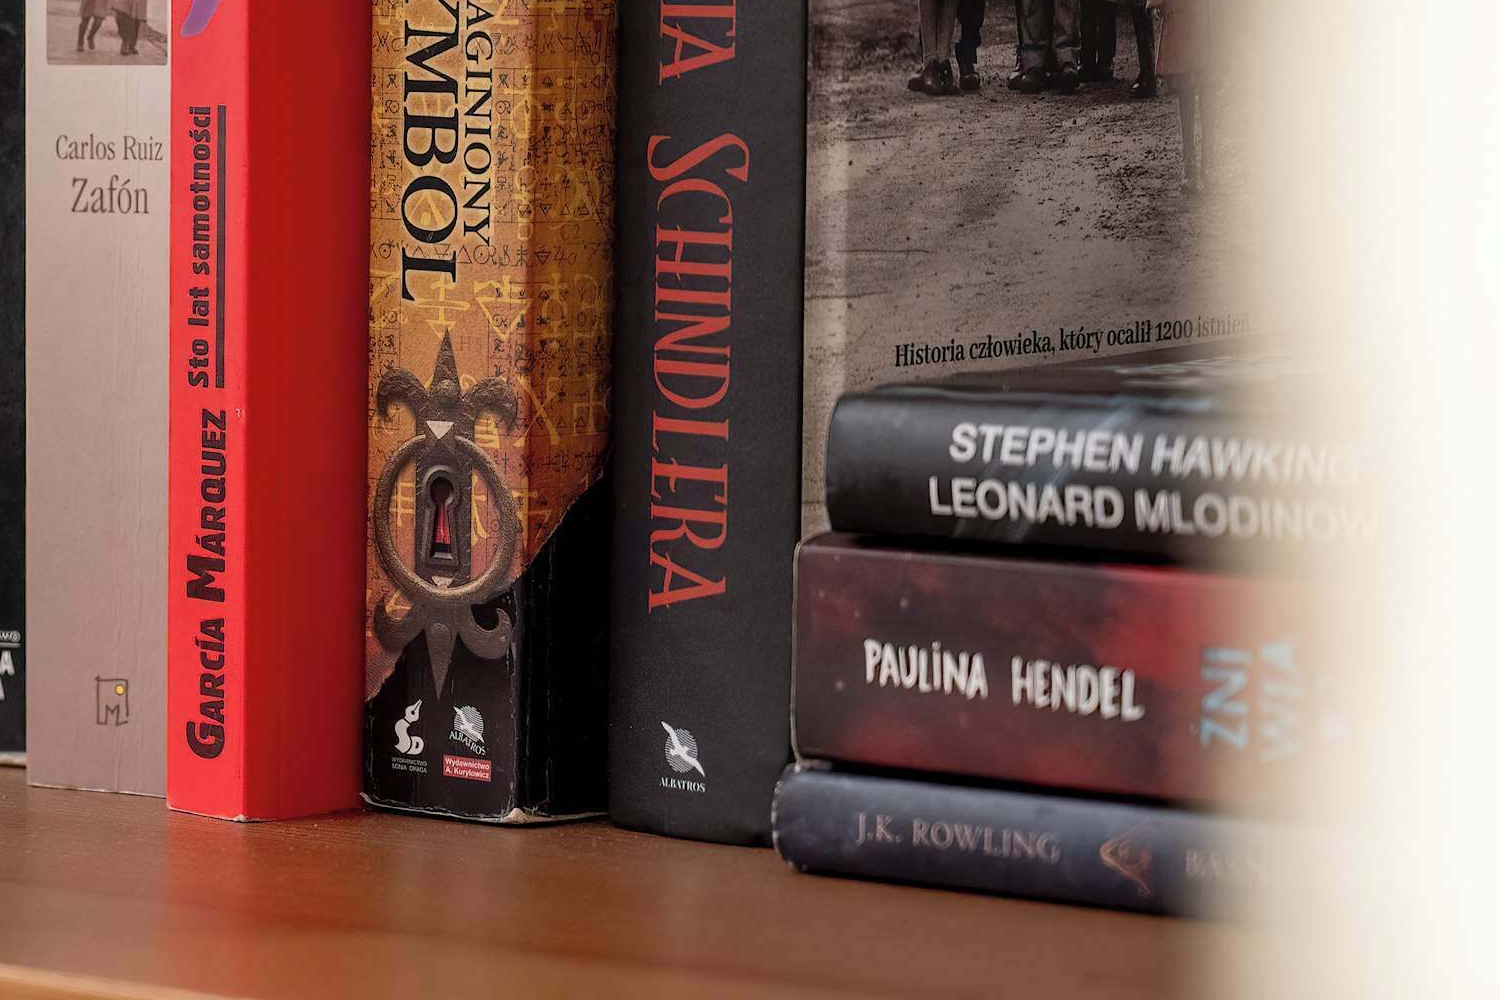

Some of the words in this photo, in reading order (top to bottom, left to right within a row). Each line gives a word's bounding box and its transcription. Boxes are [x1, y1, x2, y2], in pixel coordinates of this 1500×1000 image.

[55, 132, 116, 161] Carlos
[123, 135, 163, 161] Ruiz
[71, 174, 149, 214] Zafón
[189, 105, 211, 276] samotności
[187, 285, 210, 327] lat
[188, 338, 210, 389] Sto
[894, 341, 965, 368] Historia
[968, 331, 1056, 361] człowieka,
[1059, 324, 1103, 354] który
[1107, 317, 1153, 347] ocalił
[1155, 319, 1193, 343] 1200
[646, 132, 750, 615] SCHINDLERA
[948, 422, 1143, 475] STEPHEN
[185, 408, 228, 603] MÁRQUEZ
[927, 475, 1125, 530] LEONARD
[185, 617, 227, 760] GARCÍA
[1010, 655, 1145, 722] HENDEL
[444, 757, 490, 770] Wydawnictwo
[449, 730, 486, 756] ALBATROS
[444, 766, 452, 774] A.
[453, 767, 490, 779] Kuryłowicz
[659, 776, 706, 793] ALBATROS
[856, 811, 901, 847] J.K.
[911, 816, 1061, 865] ROWLING
